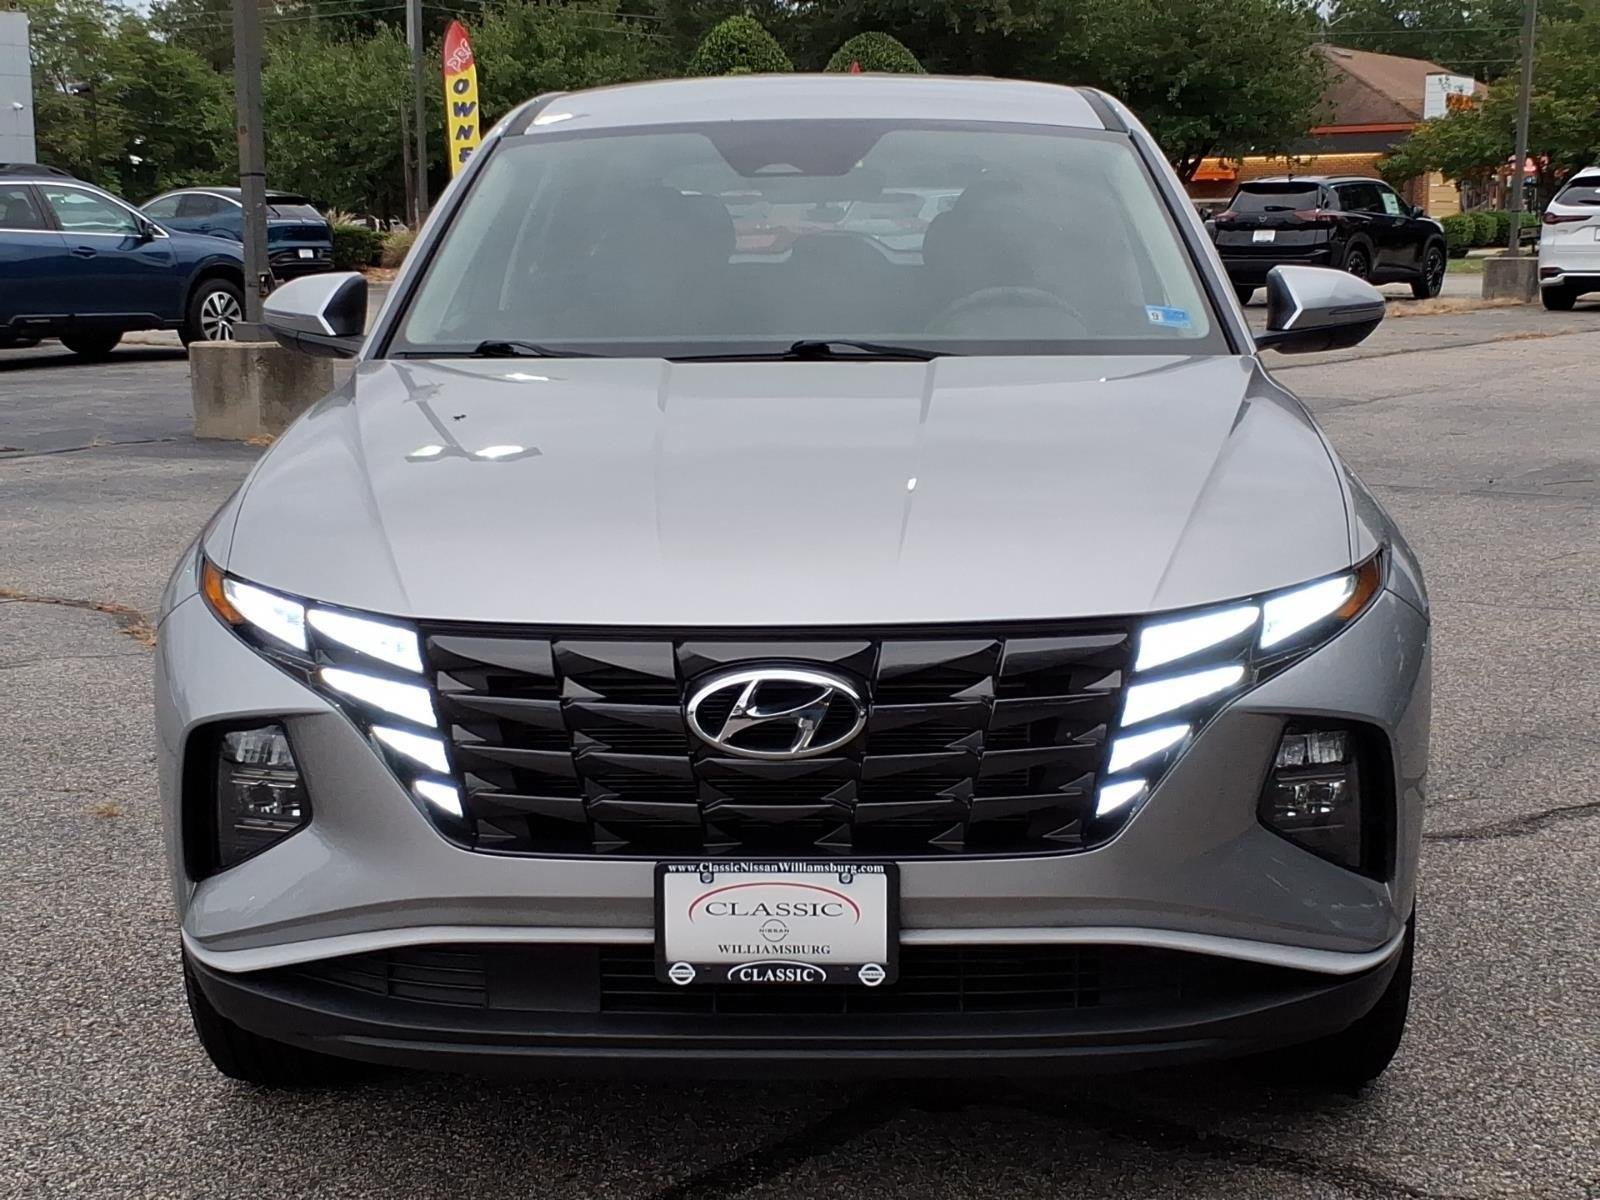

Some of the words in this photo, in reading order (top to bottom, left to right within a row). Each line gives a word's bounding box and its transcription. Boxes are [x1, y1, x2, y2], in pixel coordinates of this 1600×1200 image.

[668, 862, 885, 874] www.ClassicNissanWilliamsburg.com
[705, 902, 843, 917] CLASSIC
[718, 944, 831, 955] WILLIAMSBURG
[739, 968, 815, 982] CLASSIC
